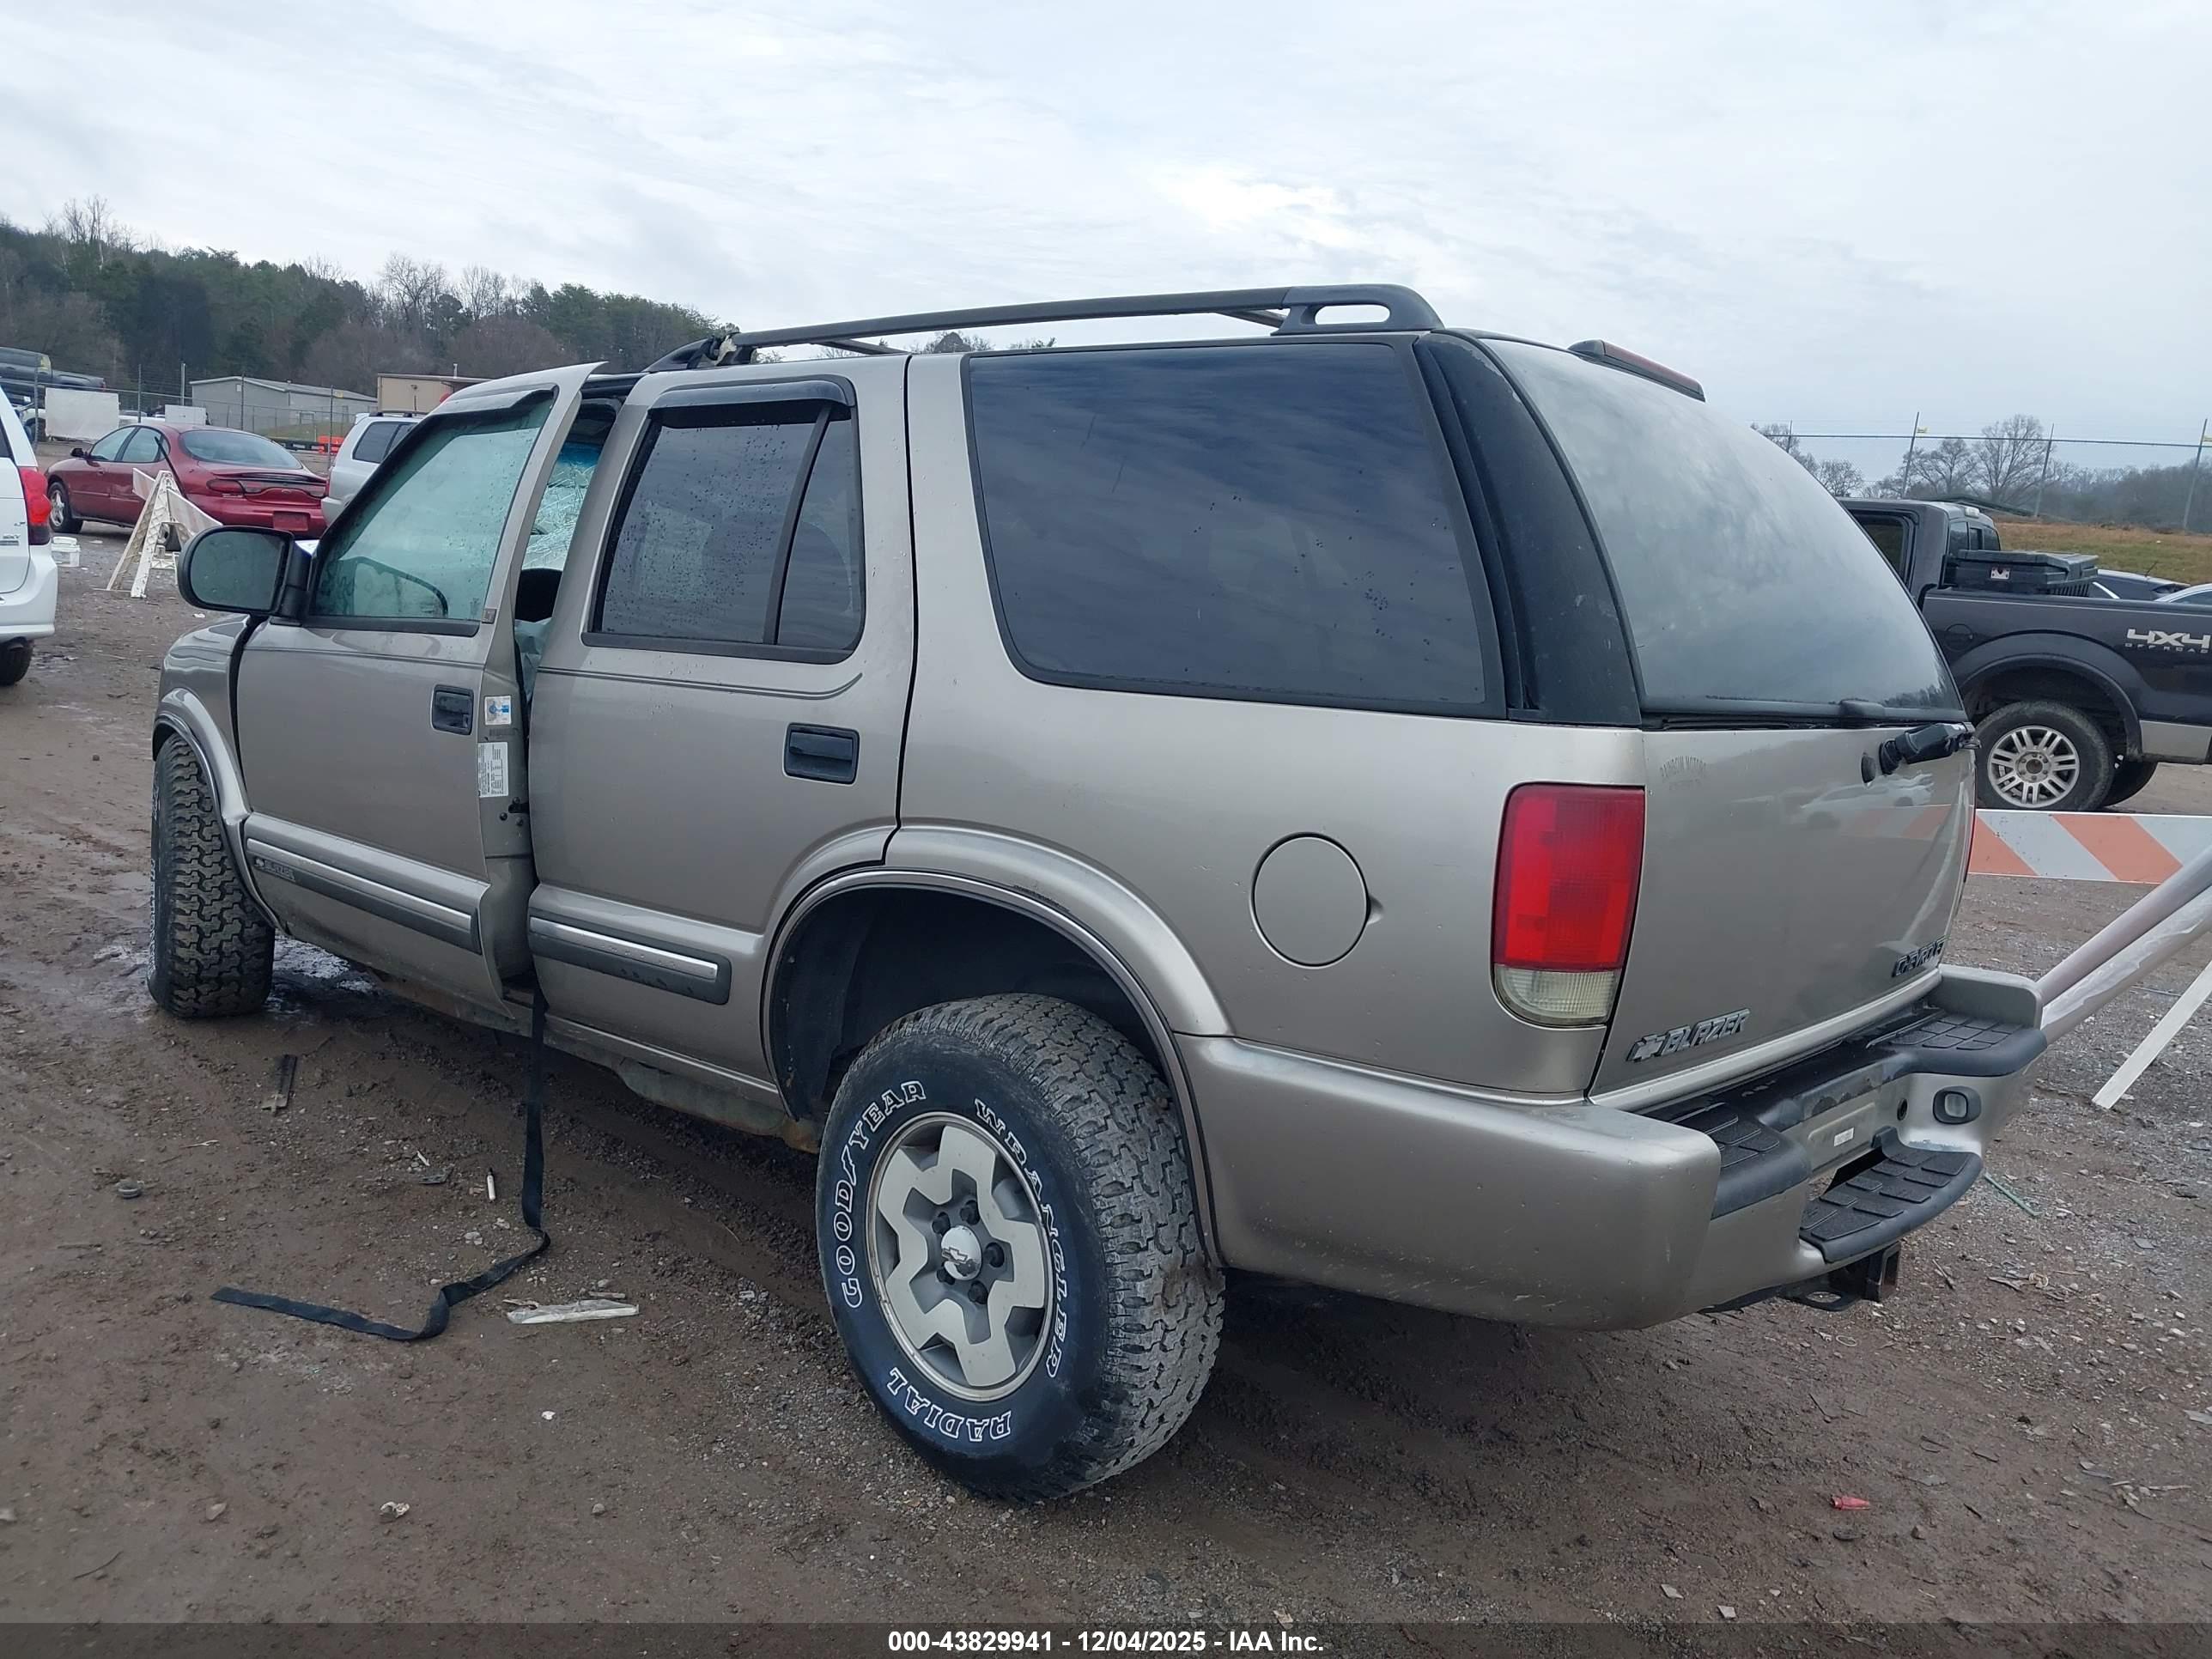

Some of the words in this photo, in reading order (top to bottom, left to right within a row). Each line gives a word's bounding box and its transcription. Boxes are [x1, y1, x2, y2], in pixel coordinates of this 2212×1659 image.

[2127, 629, 2211, 649] 4X4
[1661, 1008, 1751, 1056] BLAZER
[834, 1080, 927, 1309] GOODYEAR
[975, 1098, 1067, 1378] WRANGLER
[886, 1366, 1012, 1442] RADIAL
